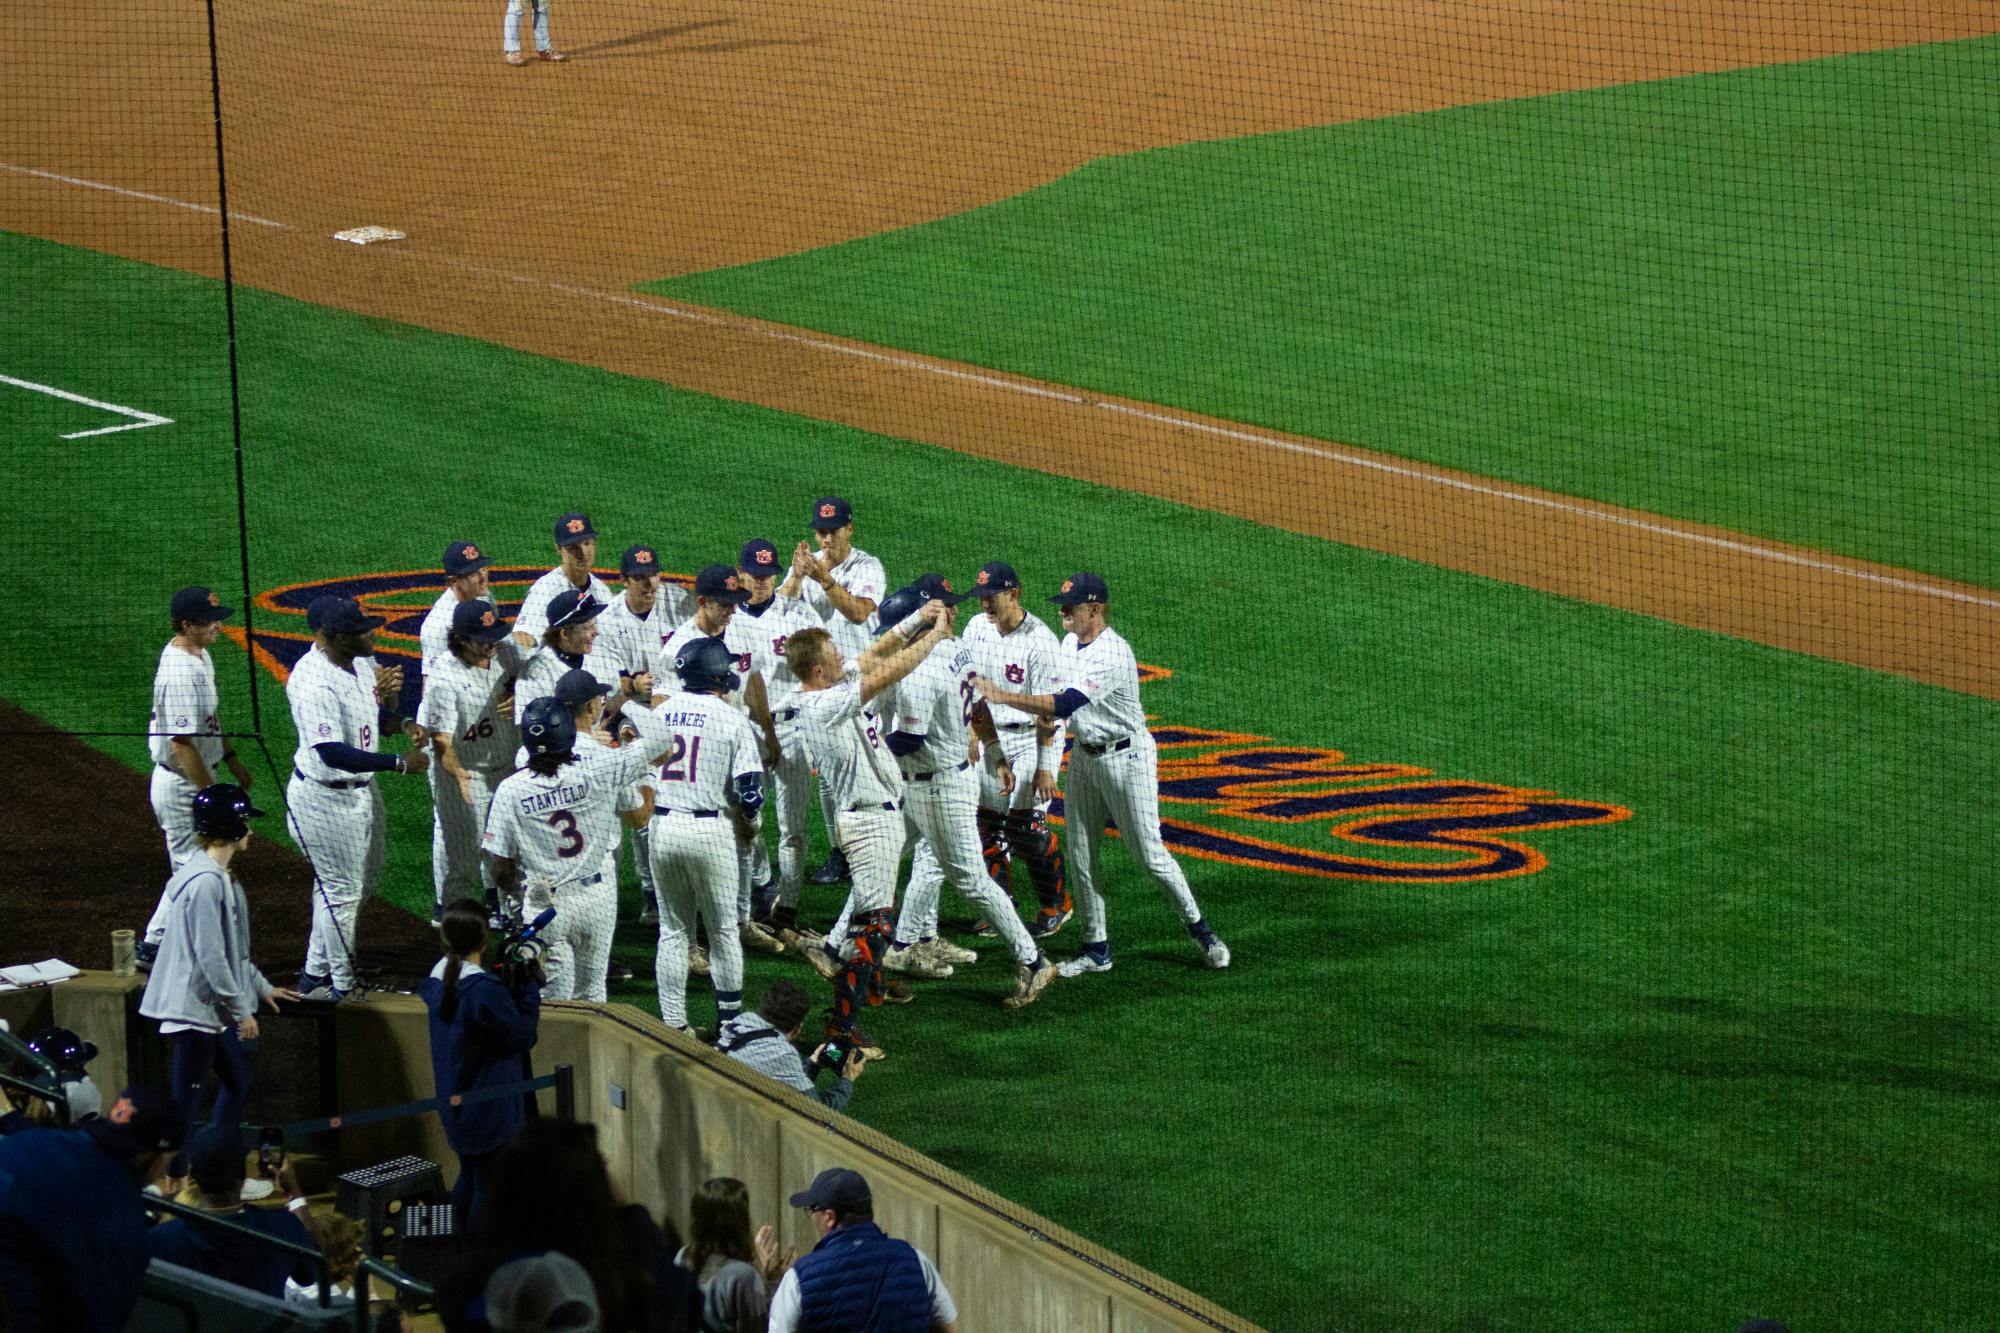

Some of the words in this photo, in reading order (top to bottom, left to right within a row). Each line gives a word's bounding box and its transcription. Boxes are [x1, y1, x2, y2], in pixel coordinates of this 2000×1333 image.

[359, 724, 371, 751] 19
[463, 718, 494, 743] 46
[661, 734, 702, 784] 21
[520, 784, 588, 815] STANFIELD
[548, 809, 585, 858] 3
